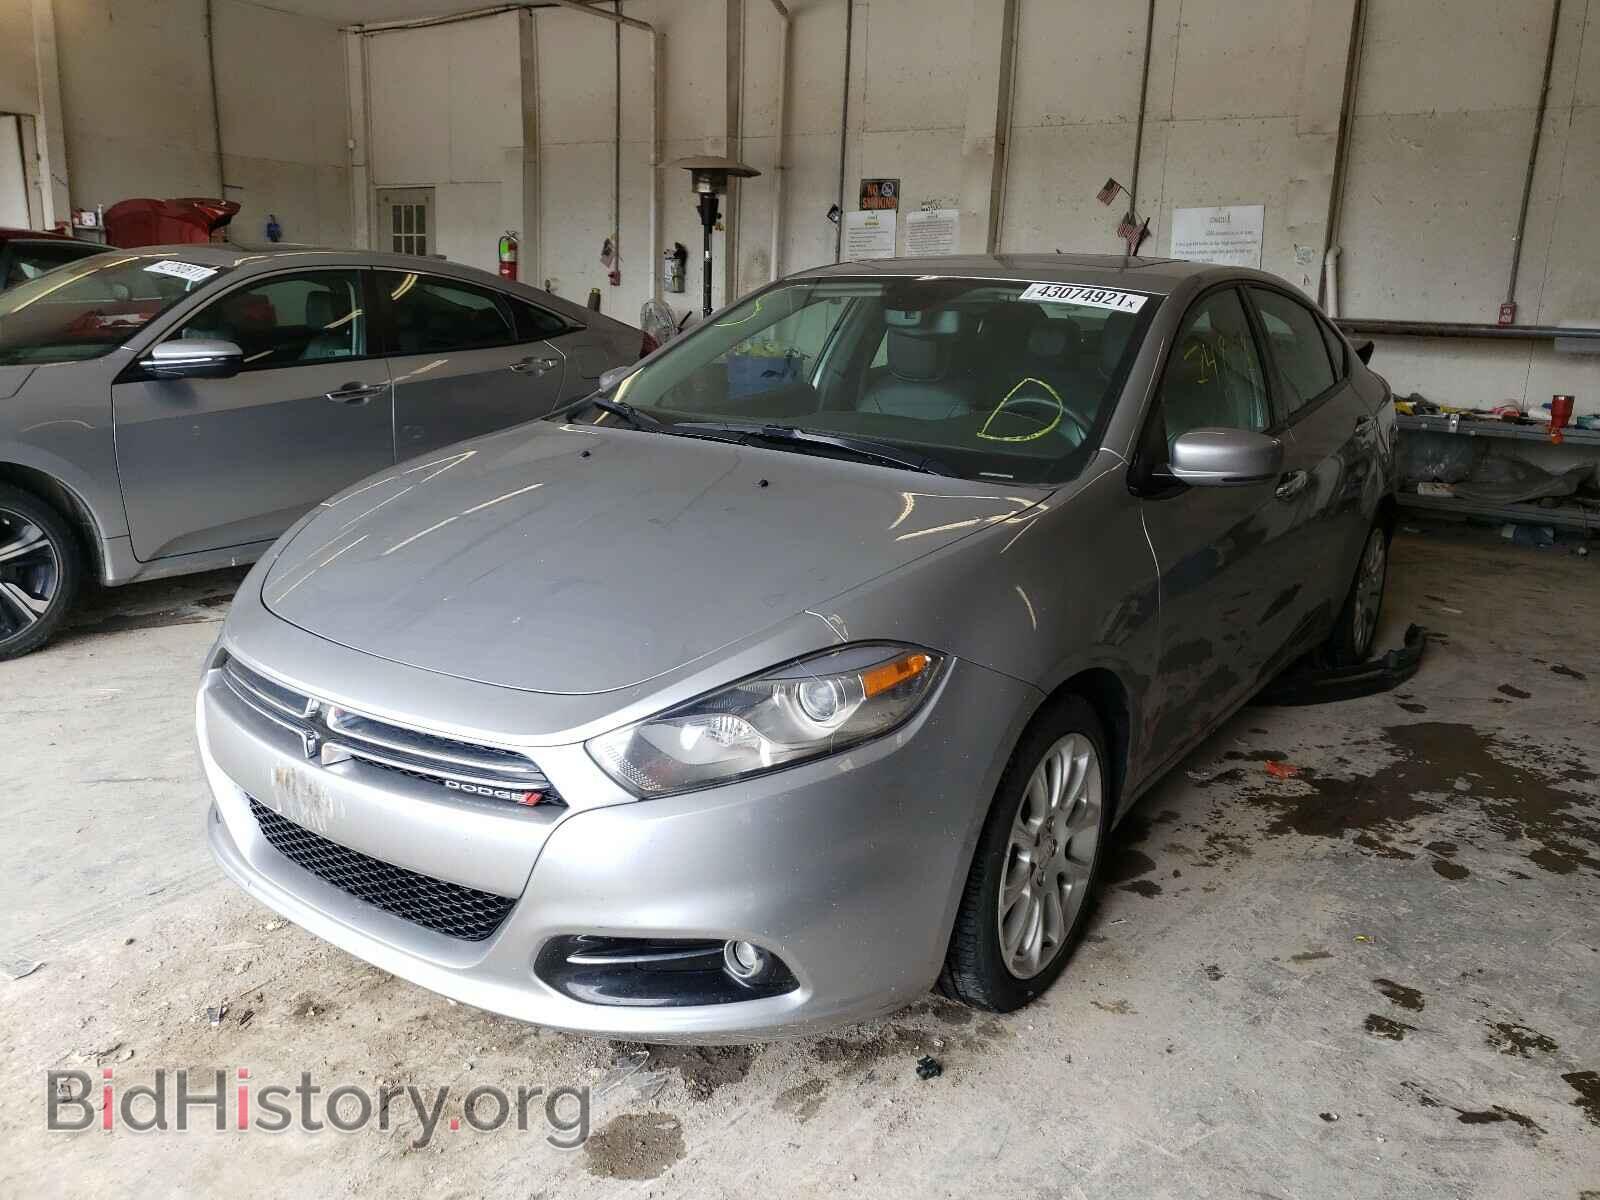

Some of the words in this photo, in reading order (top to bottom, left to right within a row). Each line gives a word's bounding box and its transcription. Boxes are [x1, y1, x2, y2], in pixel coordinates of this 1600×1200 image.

[867, 182, 879, 196] NO
[863, 197, 897, 209] SMOKING
[445, 780, 523, 801] DODGE
